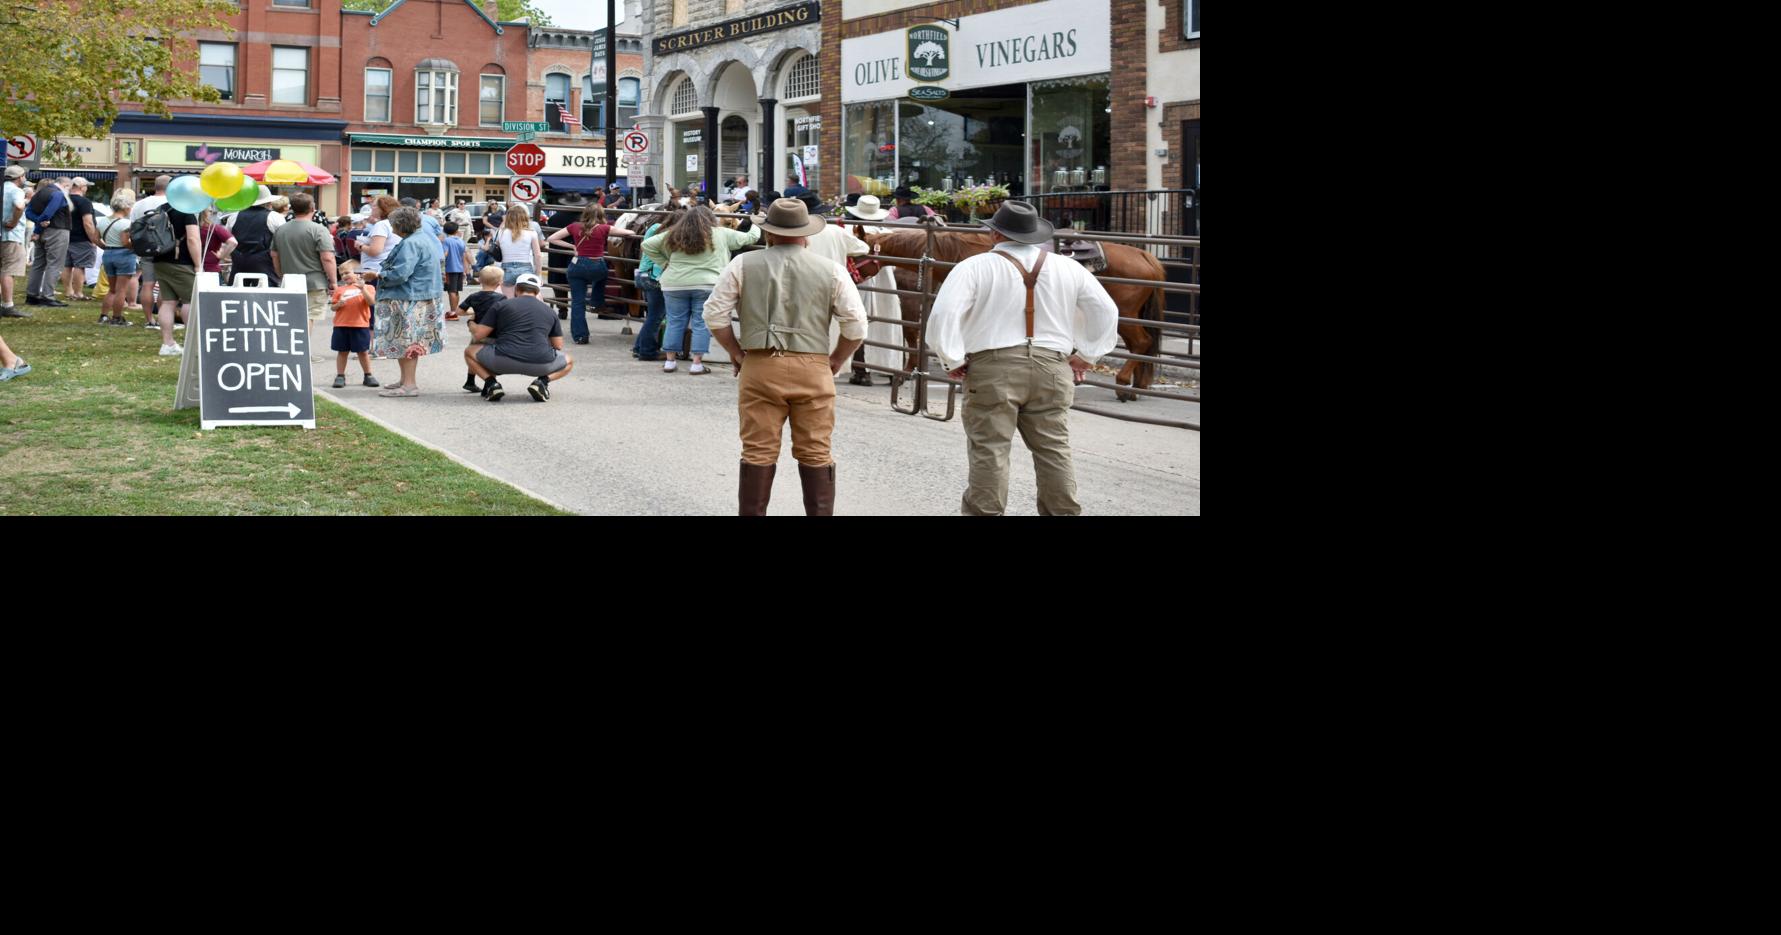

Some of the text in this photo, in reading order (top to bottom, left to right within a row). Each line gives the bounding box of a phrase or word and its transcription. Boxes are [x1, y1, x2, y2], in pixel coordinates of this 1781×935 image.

[659, 8, 809, 51] SCRIVER BUILDING
[909, 30, 948, 41] NORTHFIELD
[976, 28, 1078, 69] VINEGARS
[855, 57, 900, 86] OLIVE
[504, 123, 547, 131] DIVISION ST
[223, 148, 272, 162] MONARCH
[404, 138, 447, 146] CHAMPION
[509, 153, 543, 166] STOP
[221, 300, 290, 327] FINE
[205, 328, 305, 355] FETTLE
[217, 363, 303, 392] OPEN
